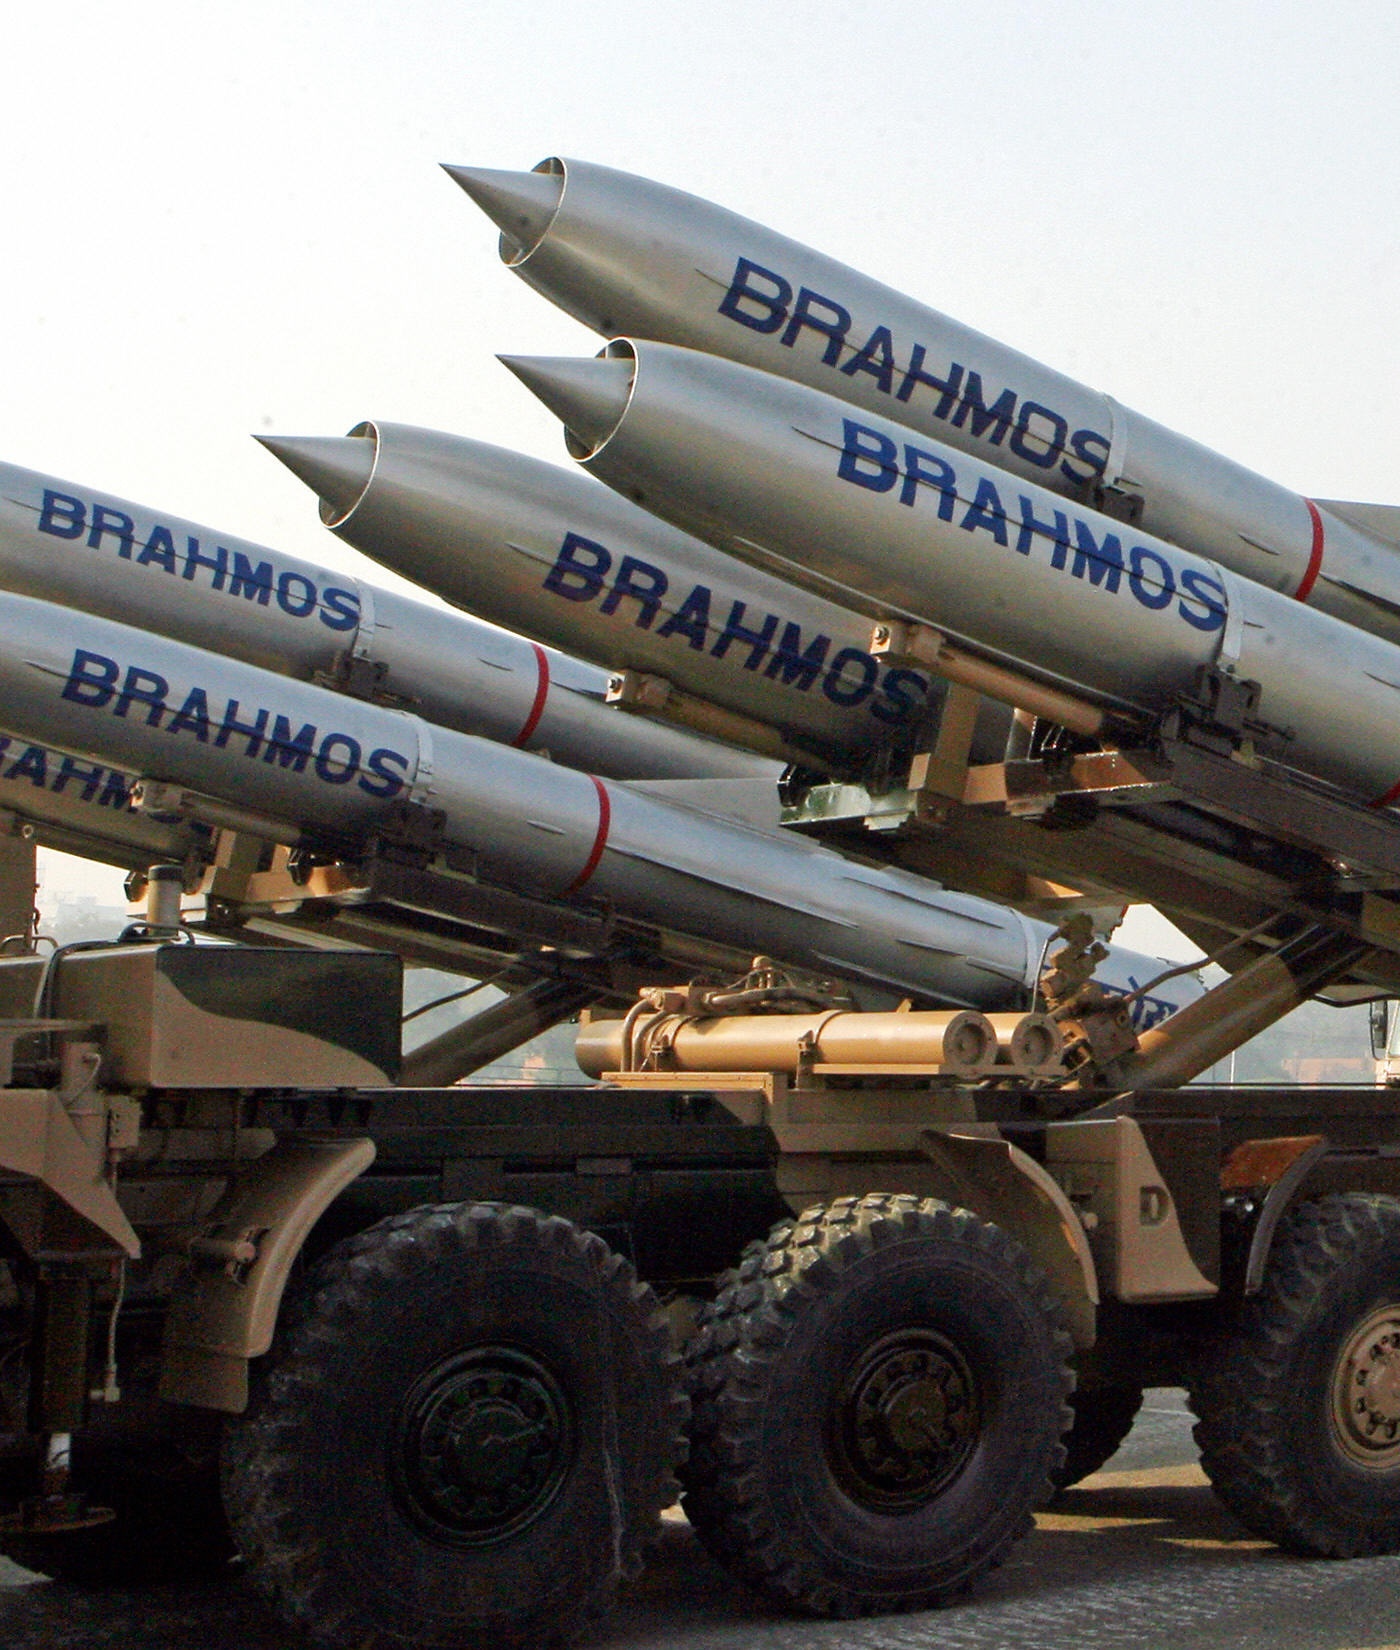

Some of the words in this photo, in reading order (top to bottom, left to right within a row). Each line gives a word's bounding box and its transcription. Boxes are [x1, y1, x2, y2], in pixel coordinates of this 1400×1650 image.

[717, 257, 1110, 487] BRAHMOS
[37, 489, 362, 633] BRAHMOS
[837, 418, 1227, 633] BRAHMOS
[60, 649, 411, 800] BRAHMOS
[542, 531, 929, 727] BRAHMOS
